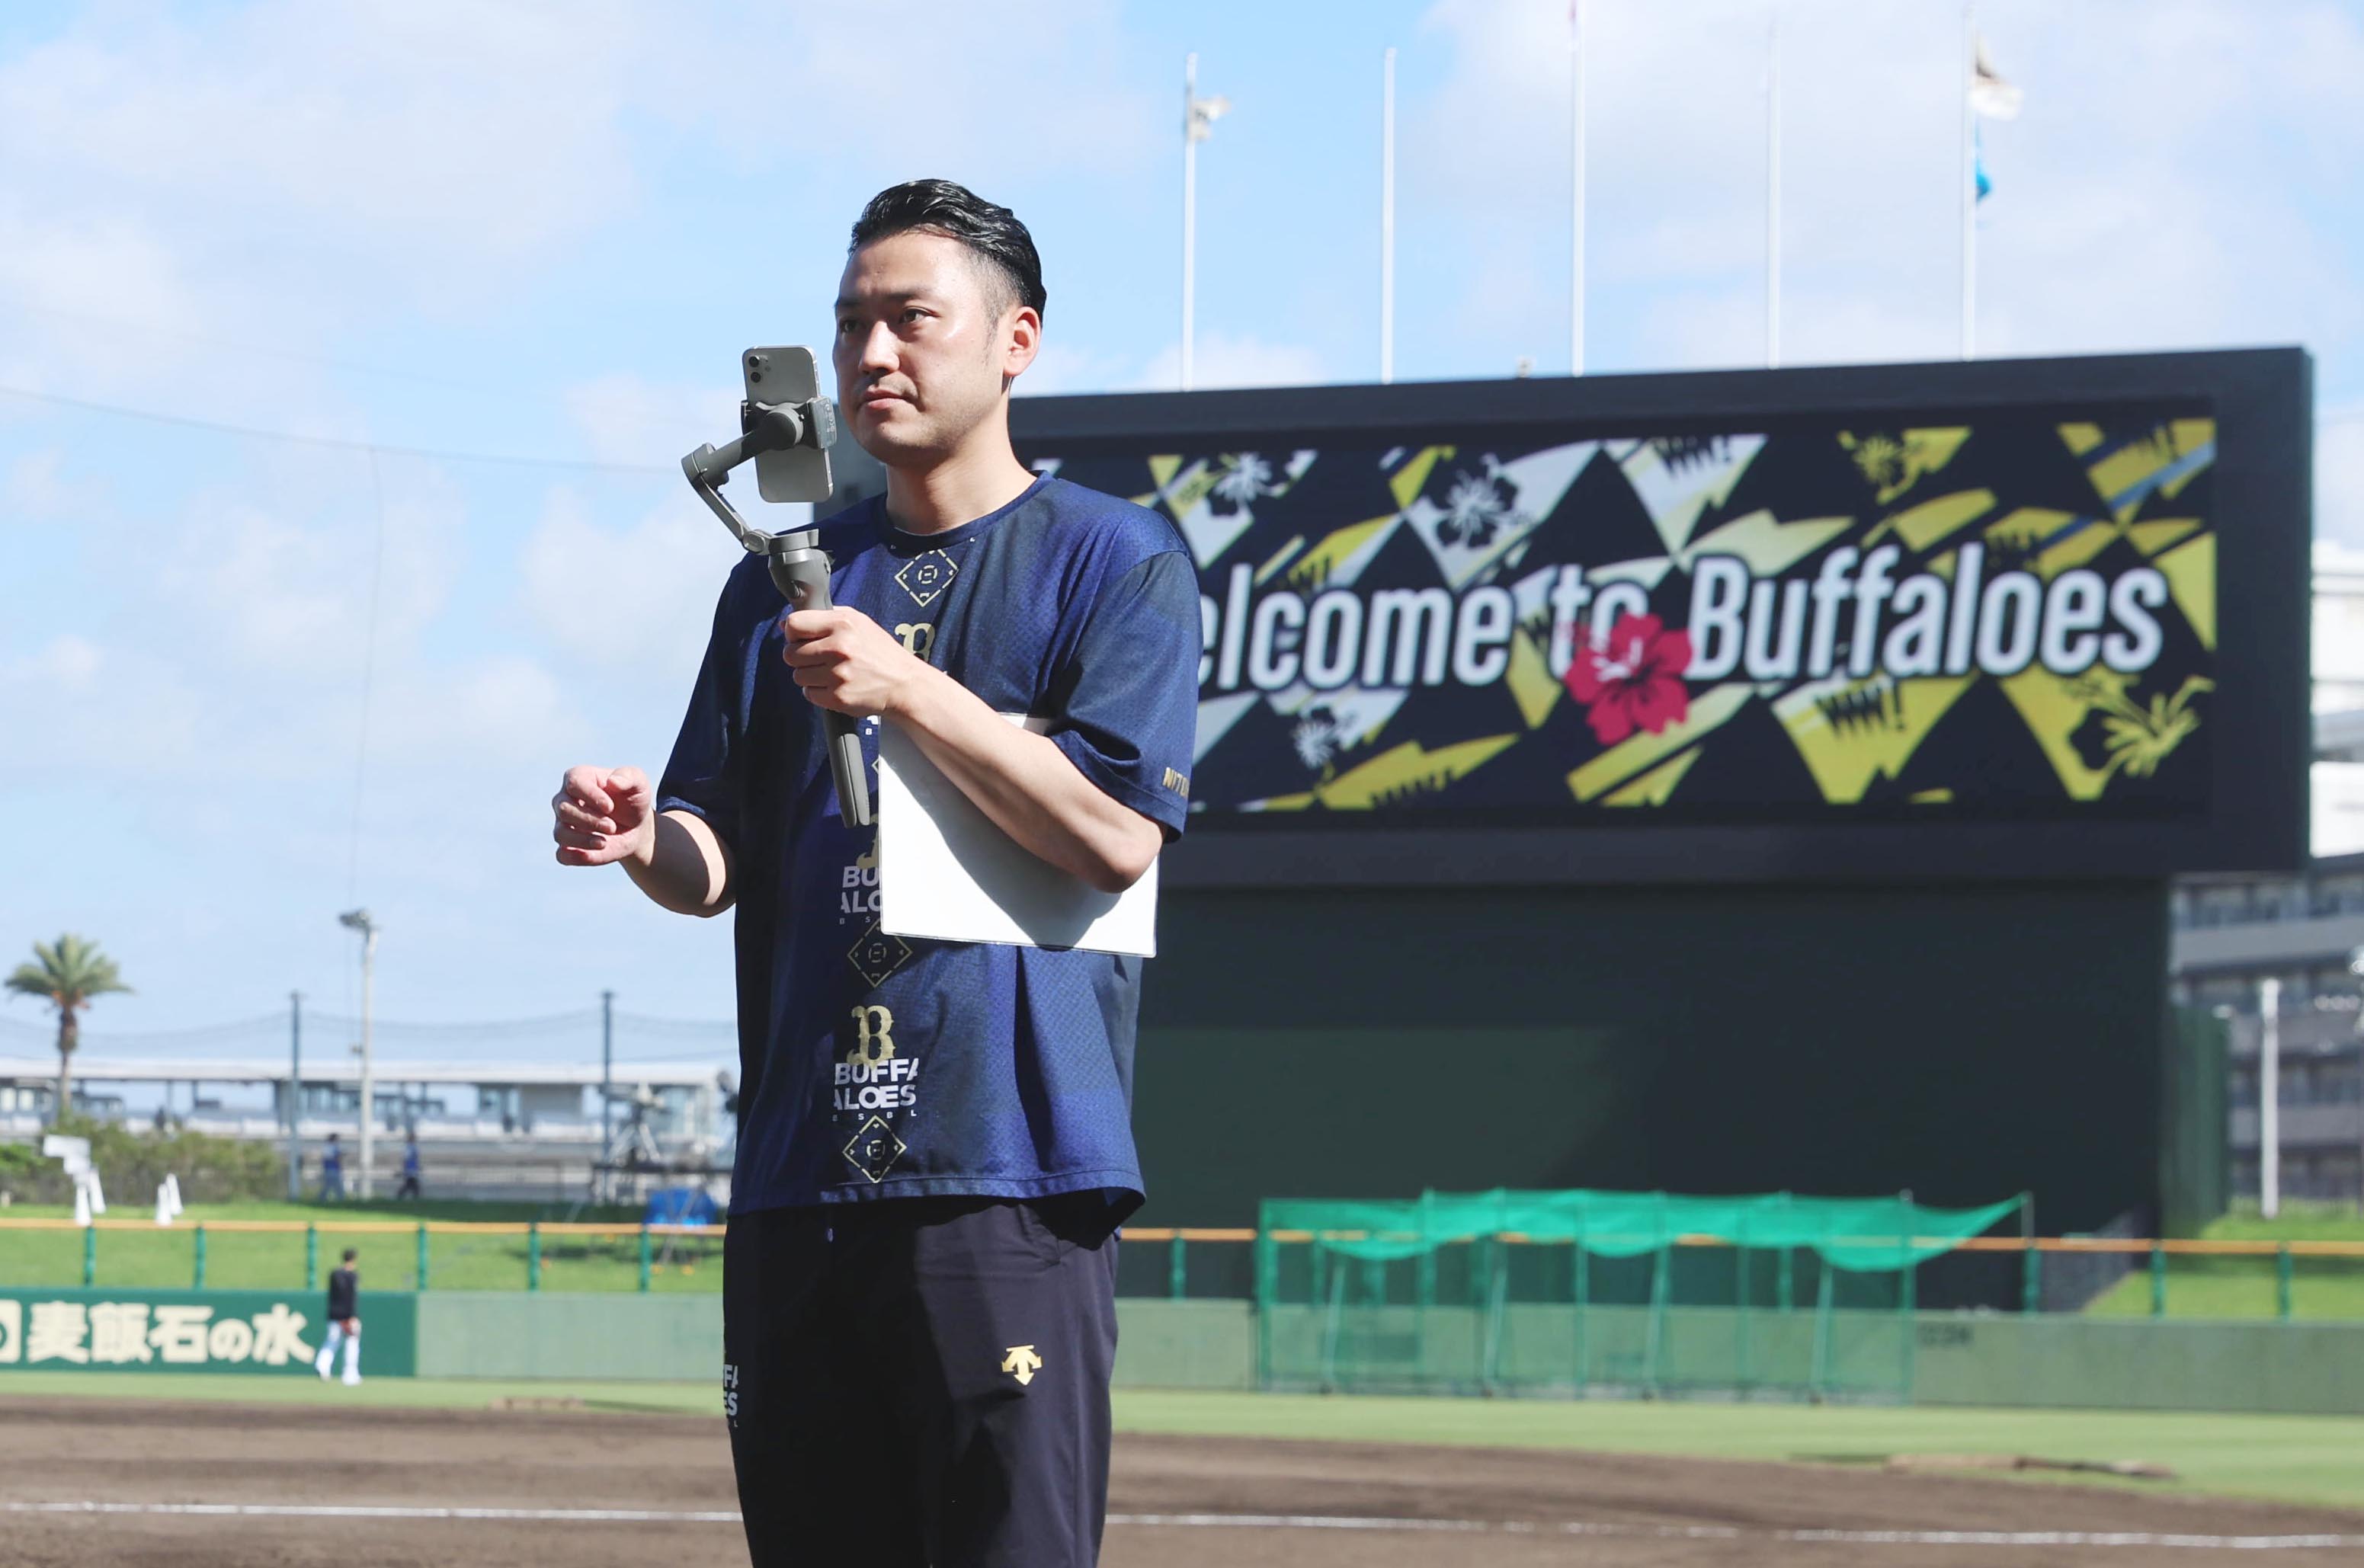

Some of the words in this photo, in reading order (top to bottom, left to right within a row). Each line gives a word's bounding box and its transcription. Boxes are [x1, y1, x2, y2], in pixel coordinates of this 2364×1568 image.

[1684, 542, 2169, 680] Buffaloes
[847, 1005, 896, 1068] B
[27, 1301, 315, 1365] 麦飯石の水
